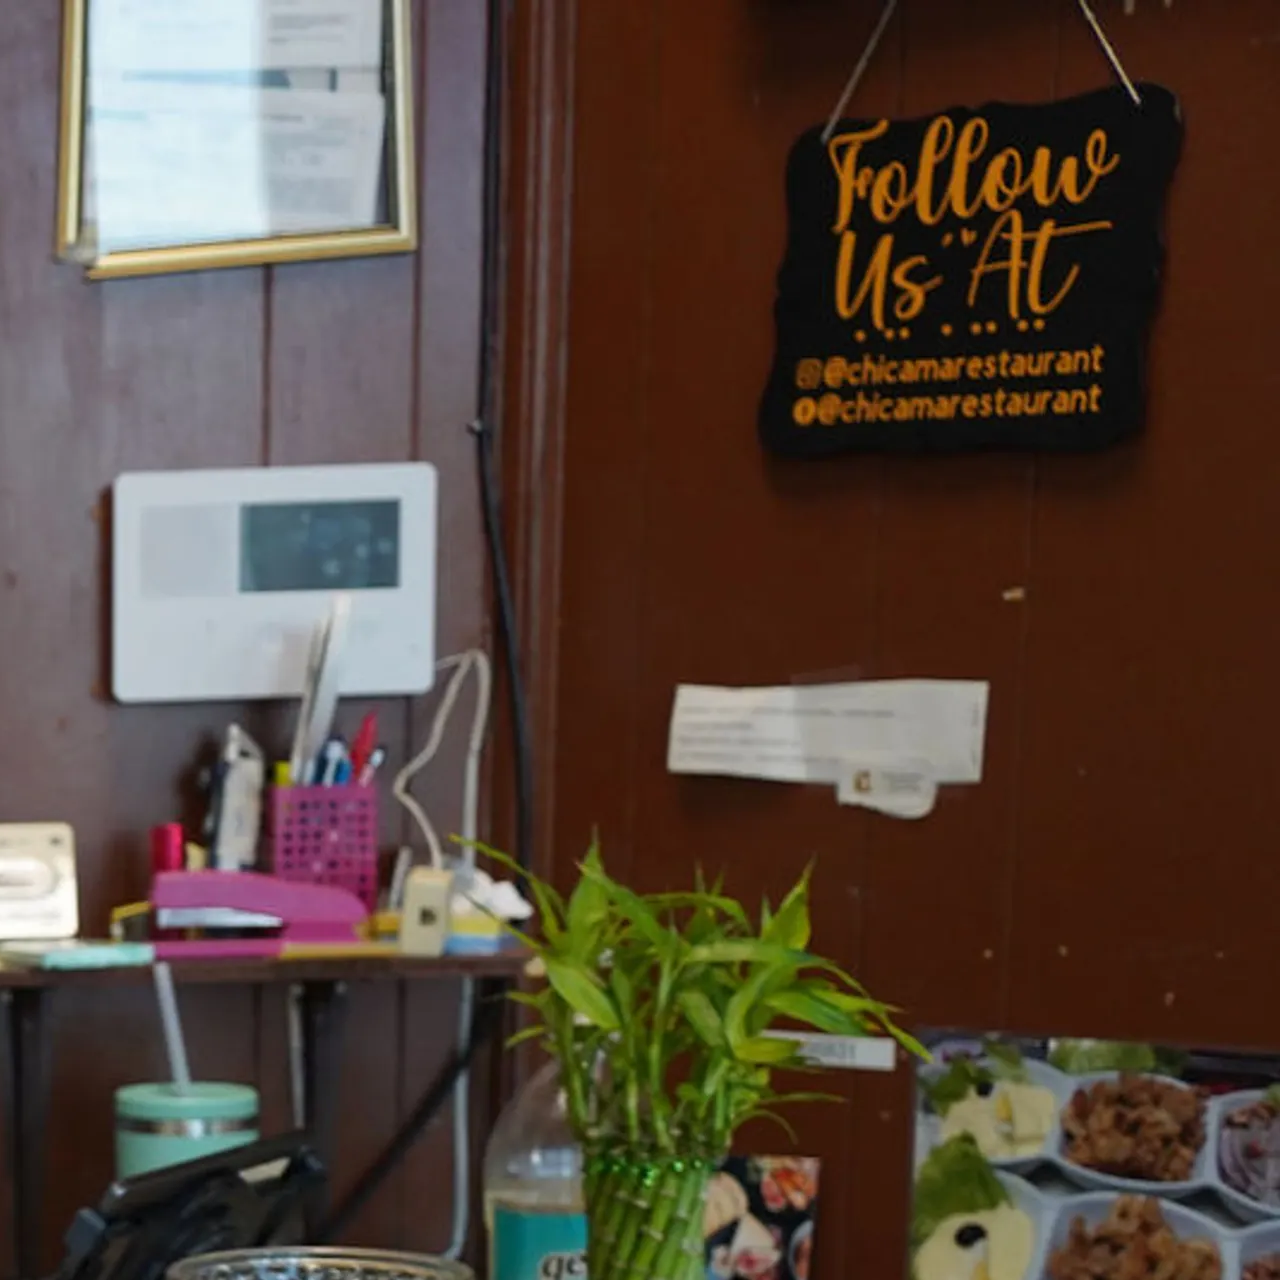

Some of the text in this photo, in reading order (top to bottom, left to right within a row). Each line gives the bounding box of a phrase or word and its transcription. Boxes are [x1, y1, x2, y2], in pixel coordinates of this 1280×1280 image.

[828, 116, 1121, 233] Follow
[834, 209, 1115, 332] Us At
[816, 383, 1102, 426] @chicamarestaurant
[823, 344, 1105, 389] @chicamarestaurant
